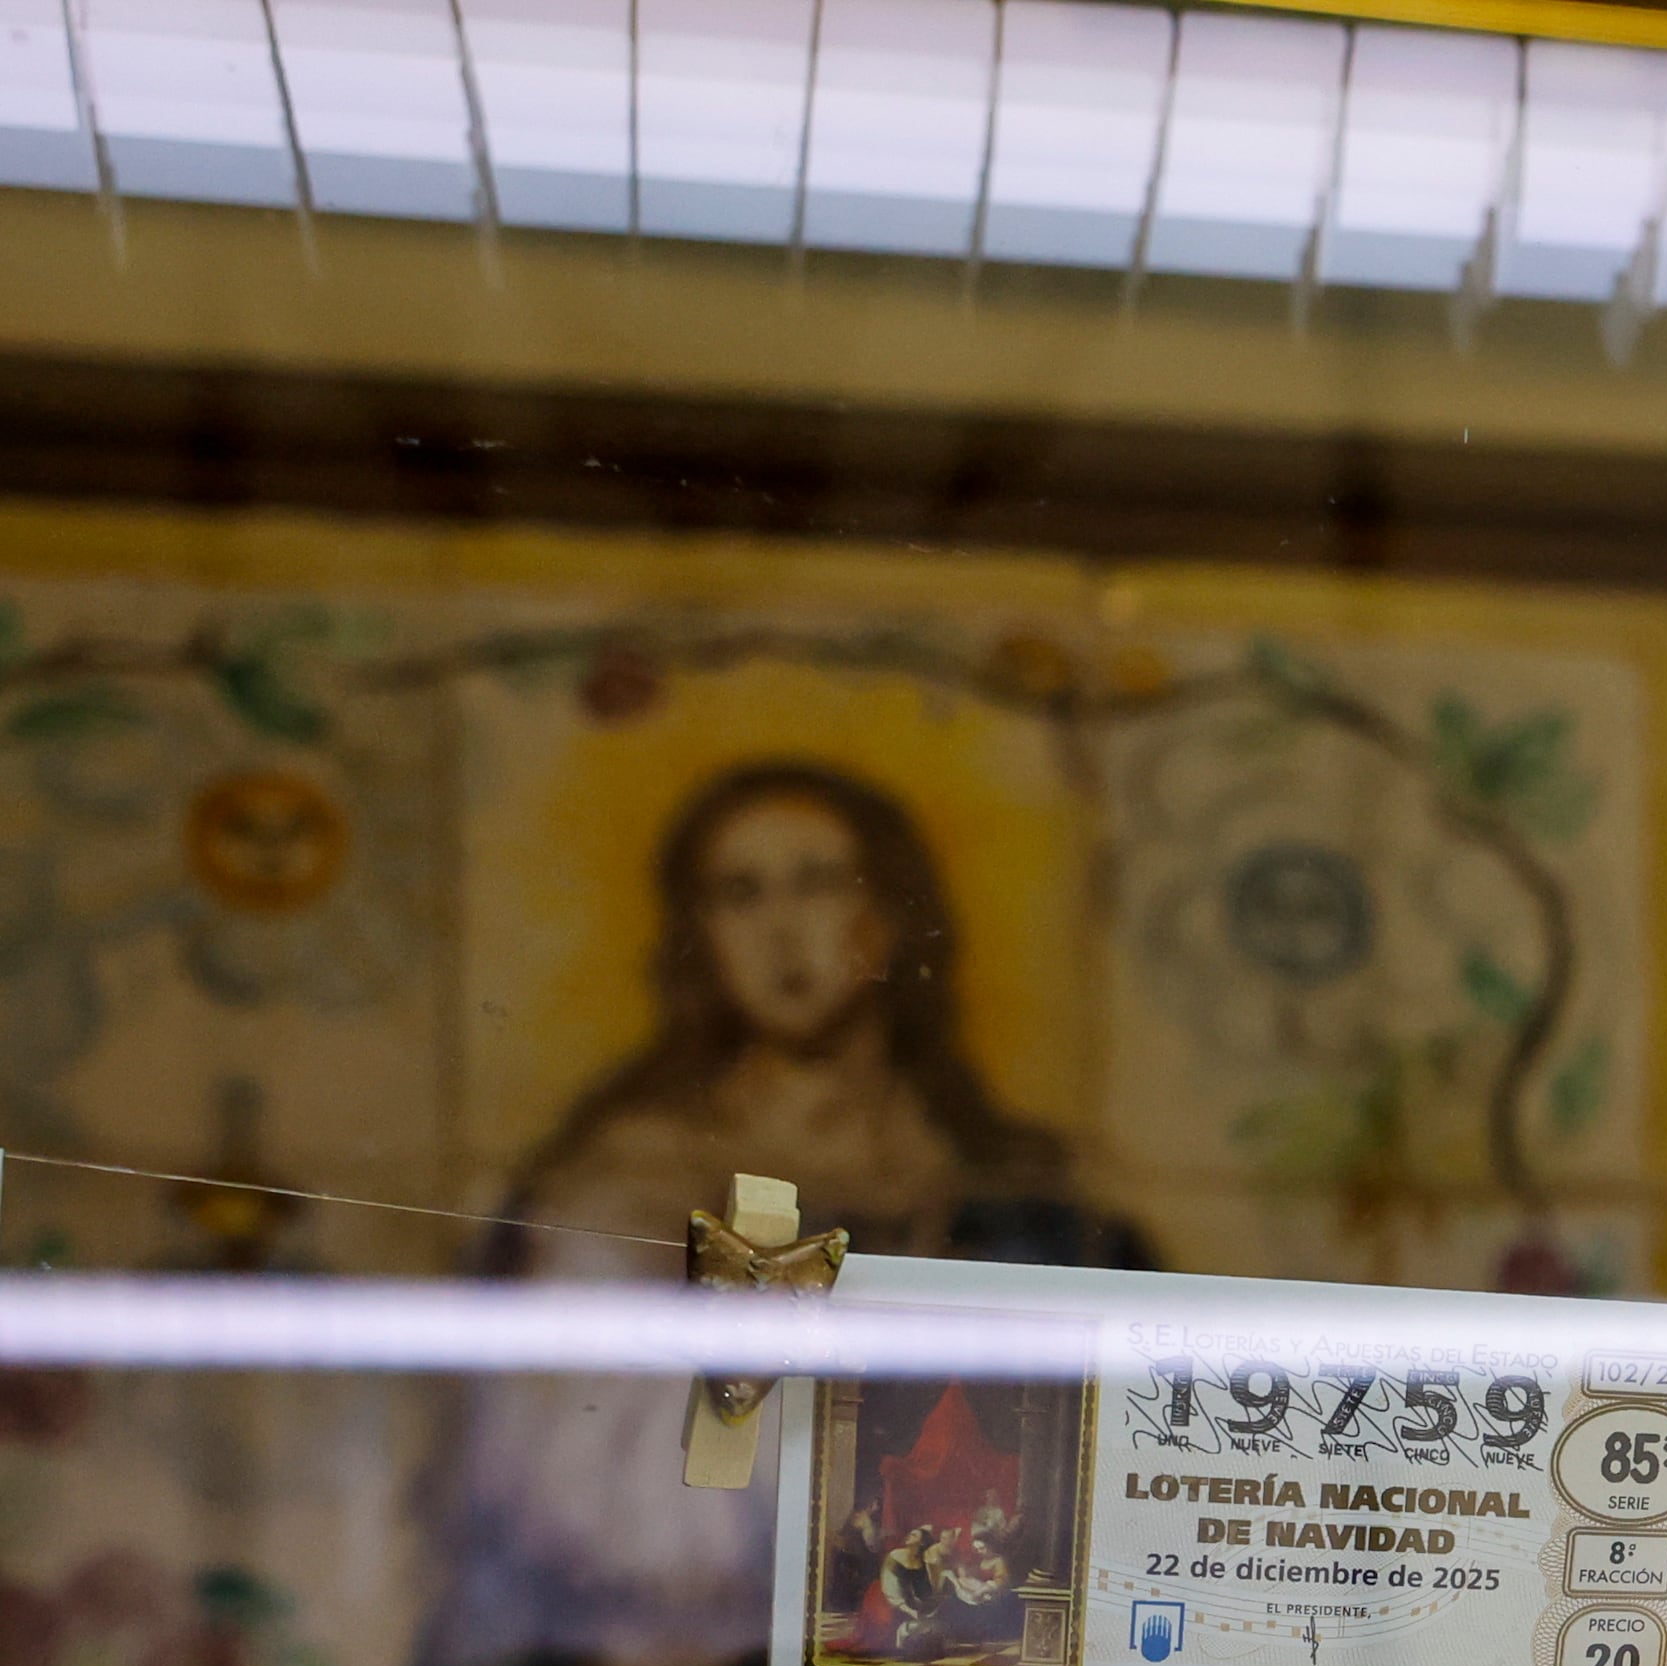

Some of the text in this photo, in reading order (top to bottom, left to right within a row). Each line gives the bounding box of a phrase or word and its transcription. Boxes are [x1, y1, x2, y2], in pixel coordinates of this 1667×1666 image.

[1155, 1356, 1545, 1448] 19759
[1125, 1472, 1531, 1519] LOTERÍA NACIONAL
[1196, 1517, 1456, 1555] DE NAVIDAD
